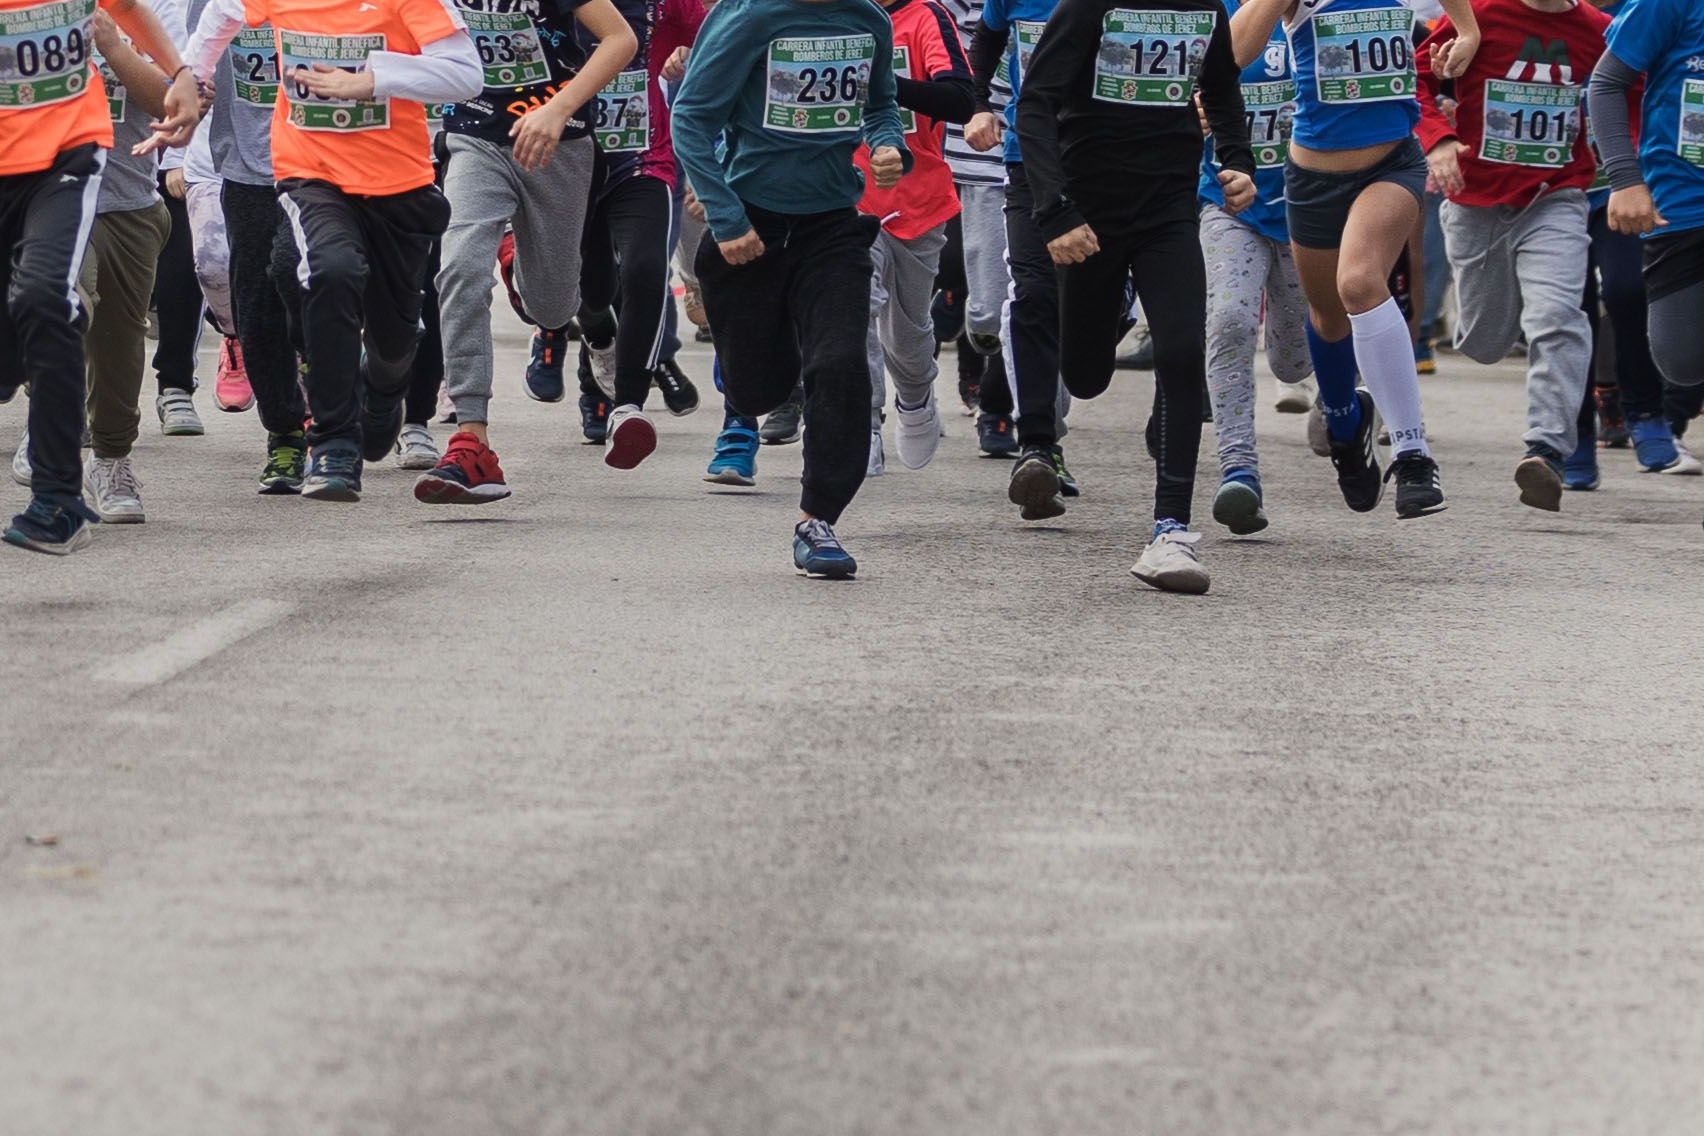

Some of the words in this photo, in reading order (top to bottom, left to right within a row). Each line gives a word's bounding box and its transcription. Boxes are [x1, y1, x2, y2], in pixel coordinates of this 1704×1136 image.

[1140, 13, 1173, 24] INFANTIL
[1318, 14, 1355, 26] CARRERA
[1356, 11, 1390, 23] INFANTIL
[1123, 23, 1161, 34] BOMBEROS
[1163, 24, 1174, 34] DE
[1175, 24, 1198, 34] JEREZ
[1336, 22, 1379, 34] BOMBEROS
[305, 36, 340, 49] INFANTIL
[475, 35, 516, 64] 63
[776, 40, 814, 51] CARRERA
[815, 40, 845, 51] INFANTIL
[17, 28, 84, 77] 089
[327, 47, 338, 59] DE
[340, 47, 365, 59] JEREZ
[793, 50, 834, 62] BOMBEROS
[835, 50, 844, 60] DE
[845, 48, 863, 60] JEREZ
[1130, 39, 1187, 76] 121
[1345, 36, 1406, 73] 100
[246, 52, 281, 82] 21
[797, 65, 857, 103] 236
[1491, 81, 1525, 93] CARRERA
[1504, 93, 1545, 105] BOMBEROS
[1510, 109, 1566, 142] 101
